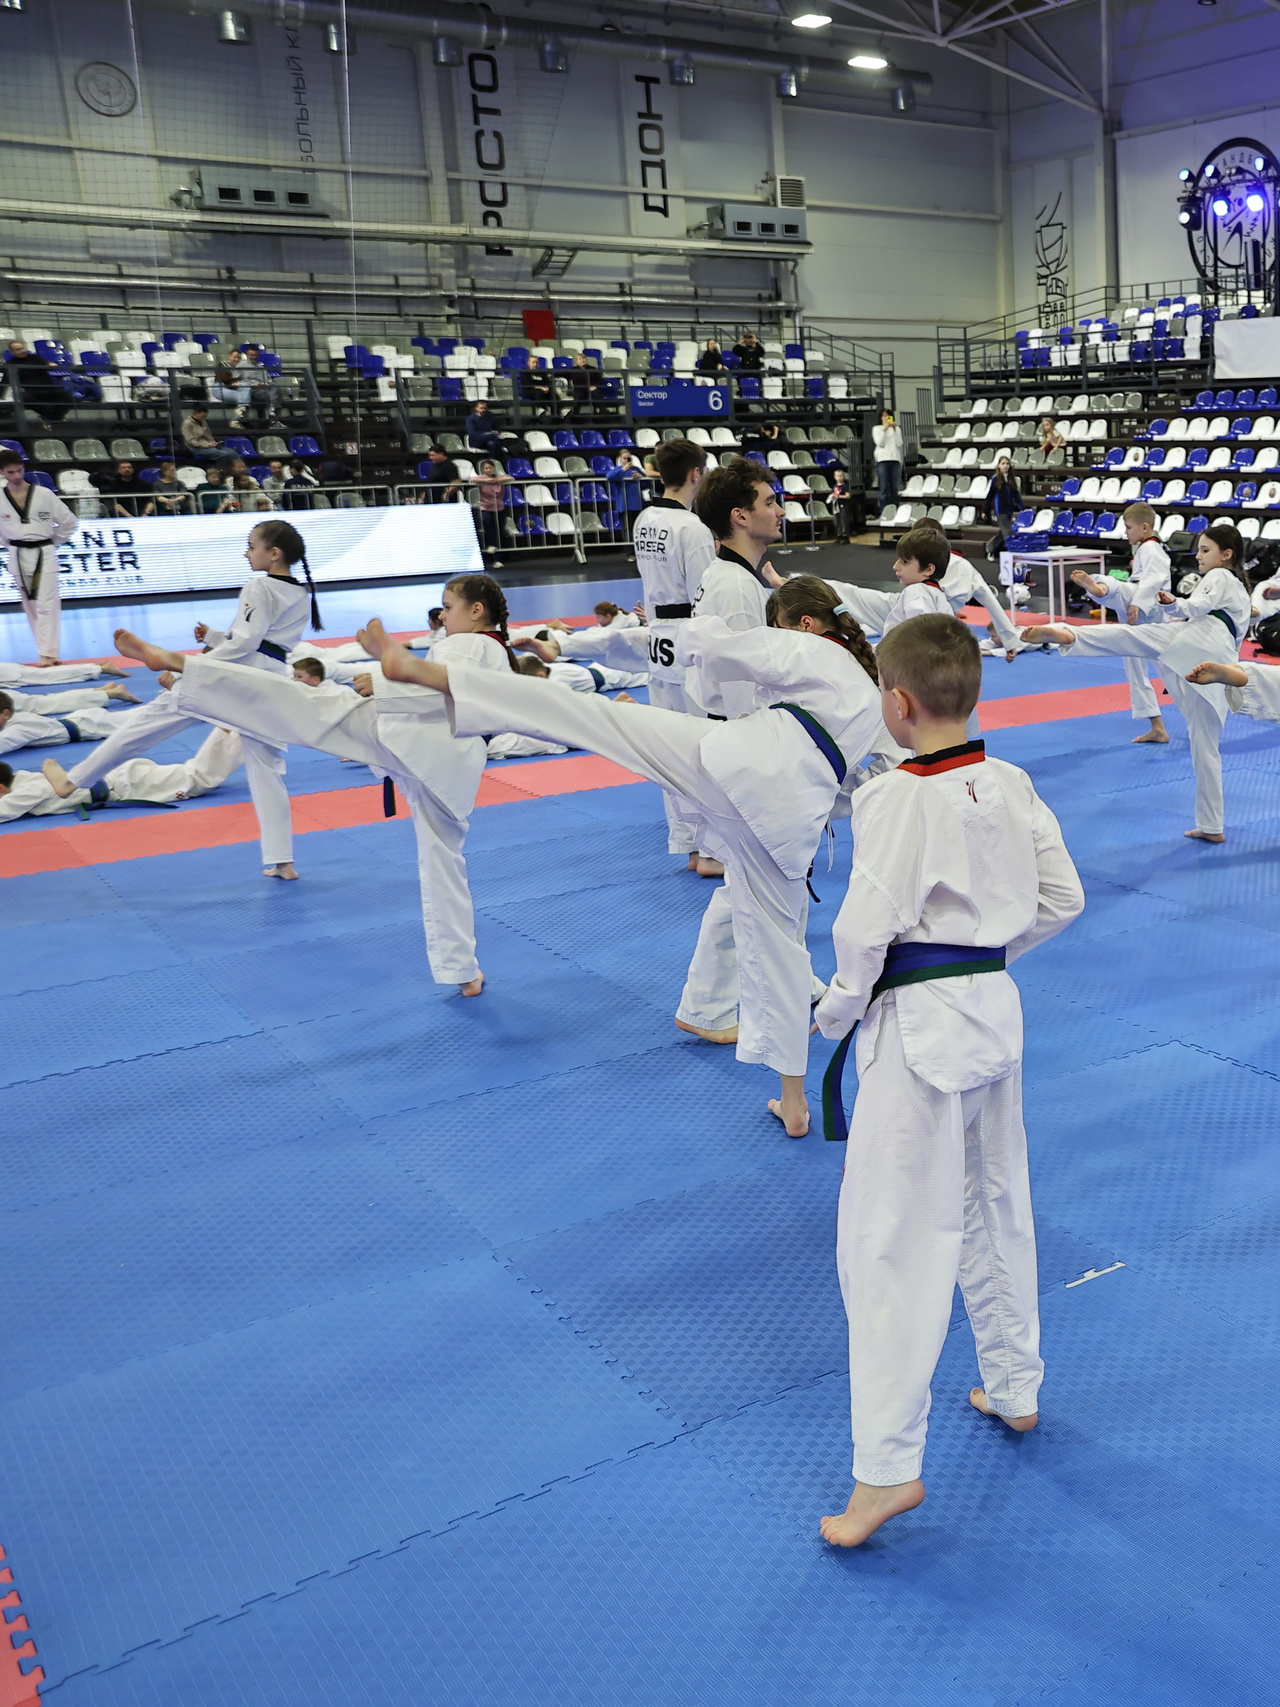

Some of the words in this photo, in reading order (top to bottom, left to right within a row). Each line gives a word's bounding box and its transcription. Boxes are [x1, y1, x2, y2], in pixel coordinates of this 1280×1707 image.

[468, 3, 513, 256] РОСТО
[635, 75, 669, 219] ДОН
[637, 390, 668, 400] Сектор
[708, 390, 723, 411] 6
